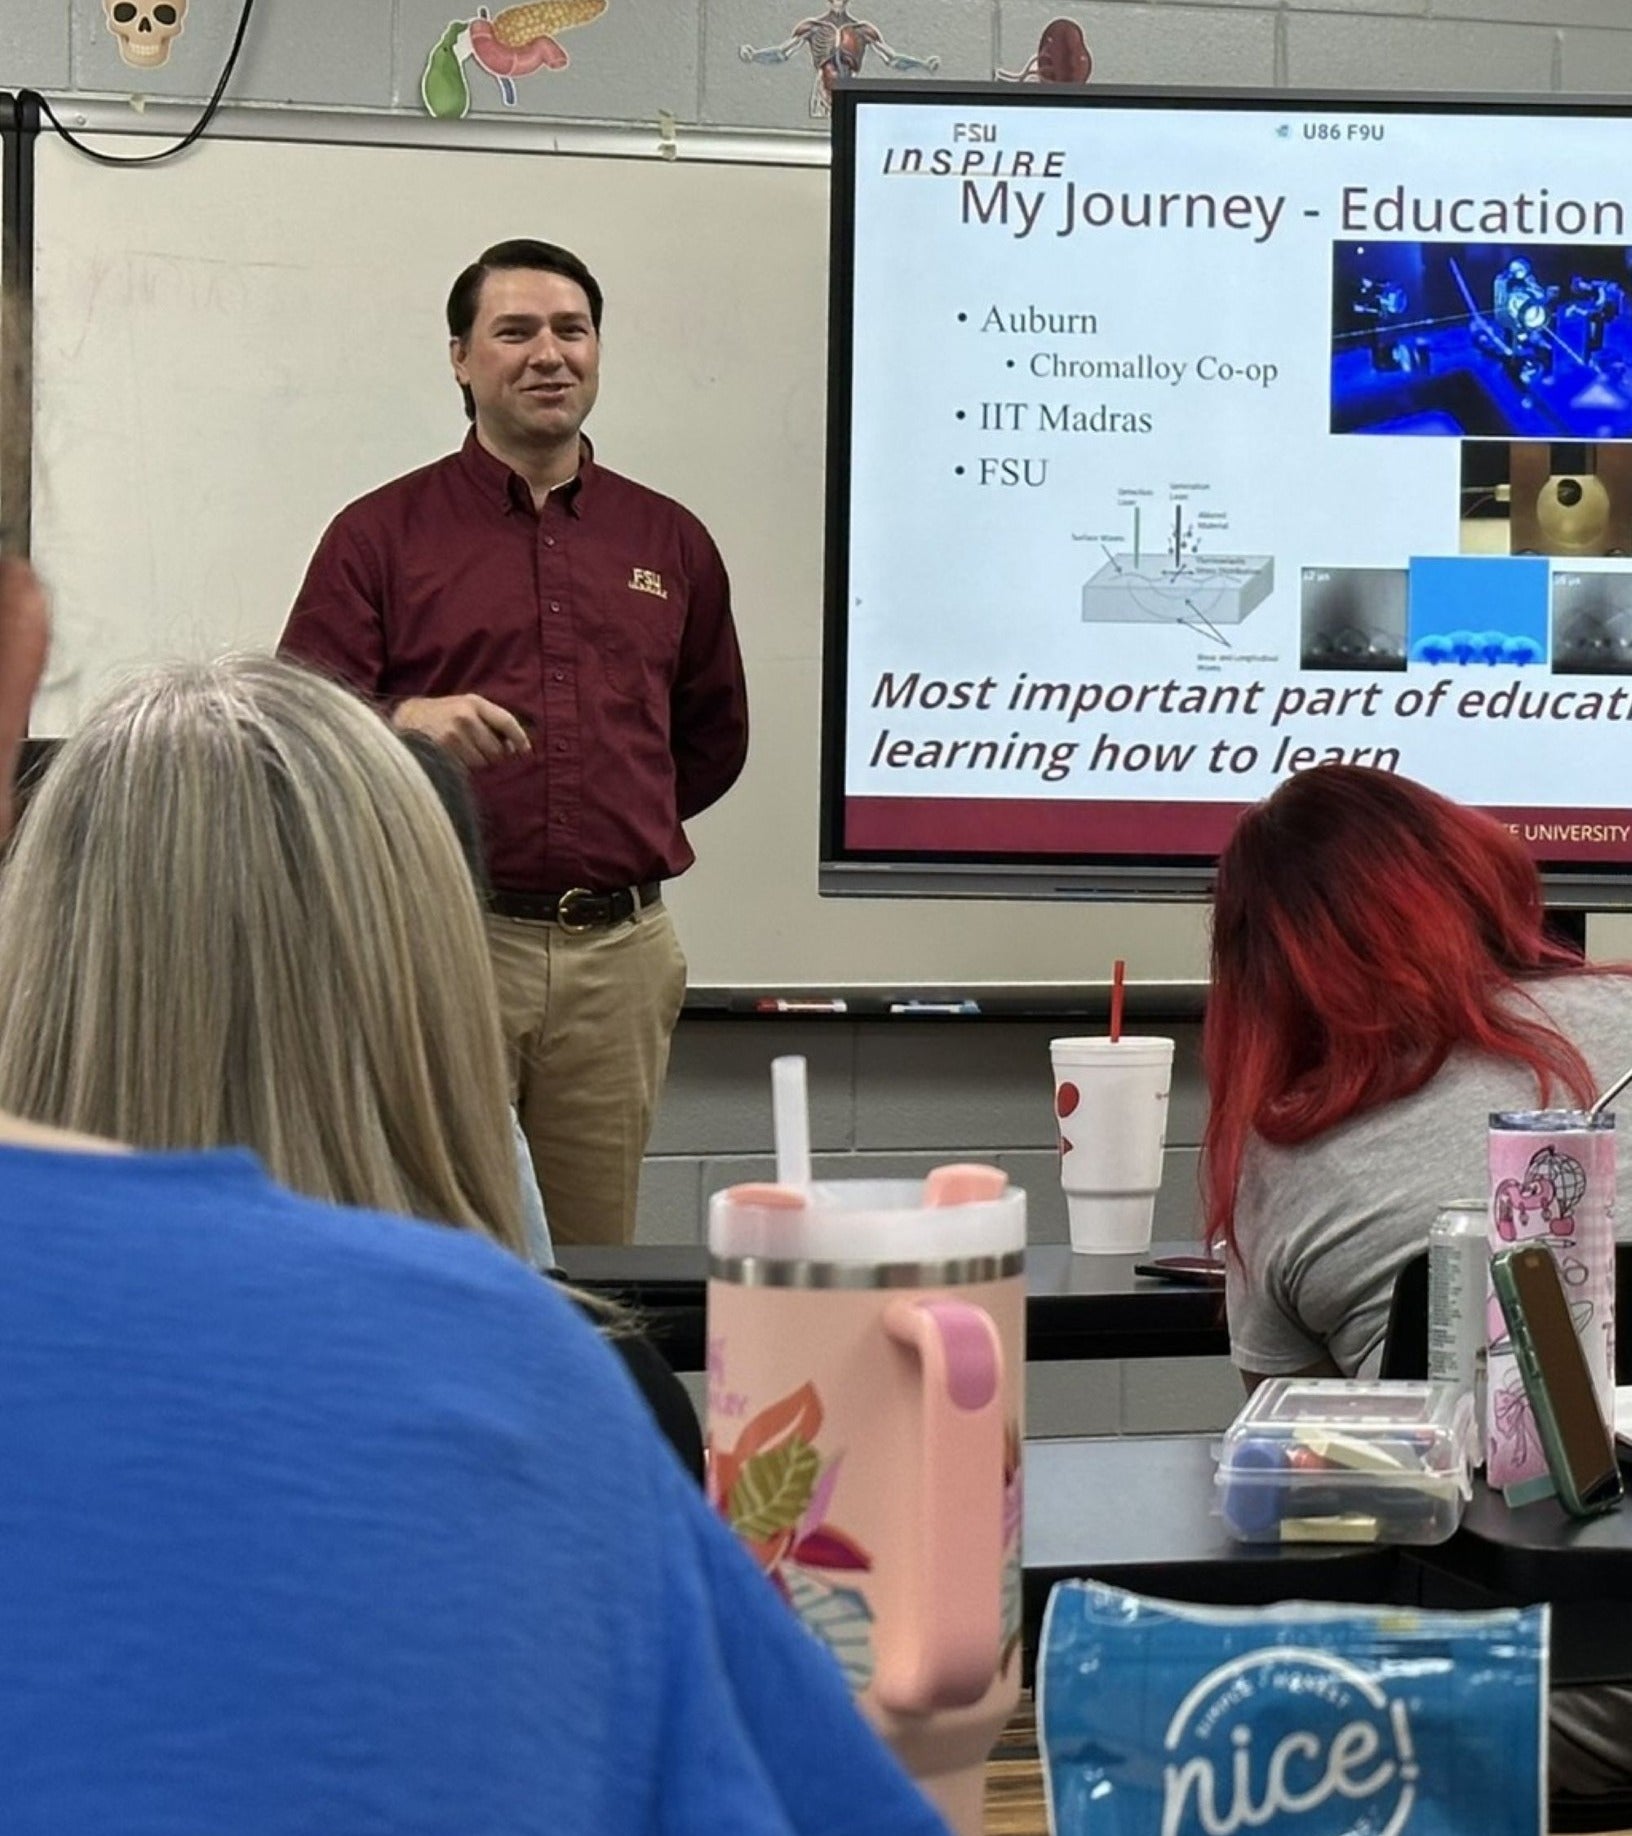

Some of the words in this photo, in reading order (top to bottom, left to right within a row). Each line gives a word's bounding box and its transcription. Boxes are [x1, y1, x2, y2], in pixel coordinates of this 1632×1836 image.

[954, 123, 996, 142] FSU
[1303, 124, 1340, 140] U86
[1347, 124, 1384, 141] F9U
[962, 180, 1044, 239] My
[1057, 182, 1285, 243] Journey
[1342, 185, 1624, 235] Education
[980, 305, 1098, 334] Auburn
[1030, 353, 1187, 386] Chromalloy
[1196, 355, 1278, 388] Co-op
[981, 402, 1028, 430] IIT
[1038, 404, 1152, 432] Madras
[978, 458, 1048, 486] FSU
[871, 672, 998, 710] Most
[1008, 673, 1265, 723] important
[1271, 680, 1383, 726] part
[1393, 679, 1453, 718] of
[869, 730, 1079, 781] learning
[1089, 733, 1197, 772] how
[1207, 749, 1259, 774] to
[1271, 736, 1400, 774] learn
[1524, 824, 1631, 842] UNIVERSITY
[1161, 1698, 1418, 1836] nice!
